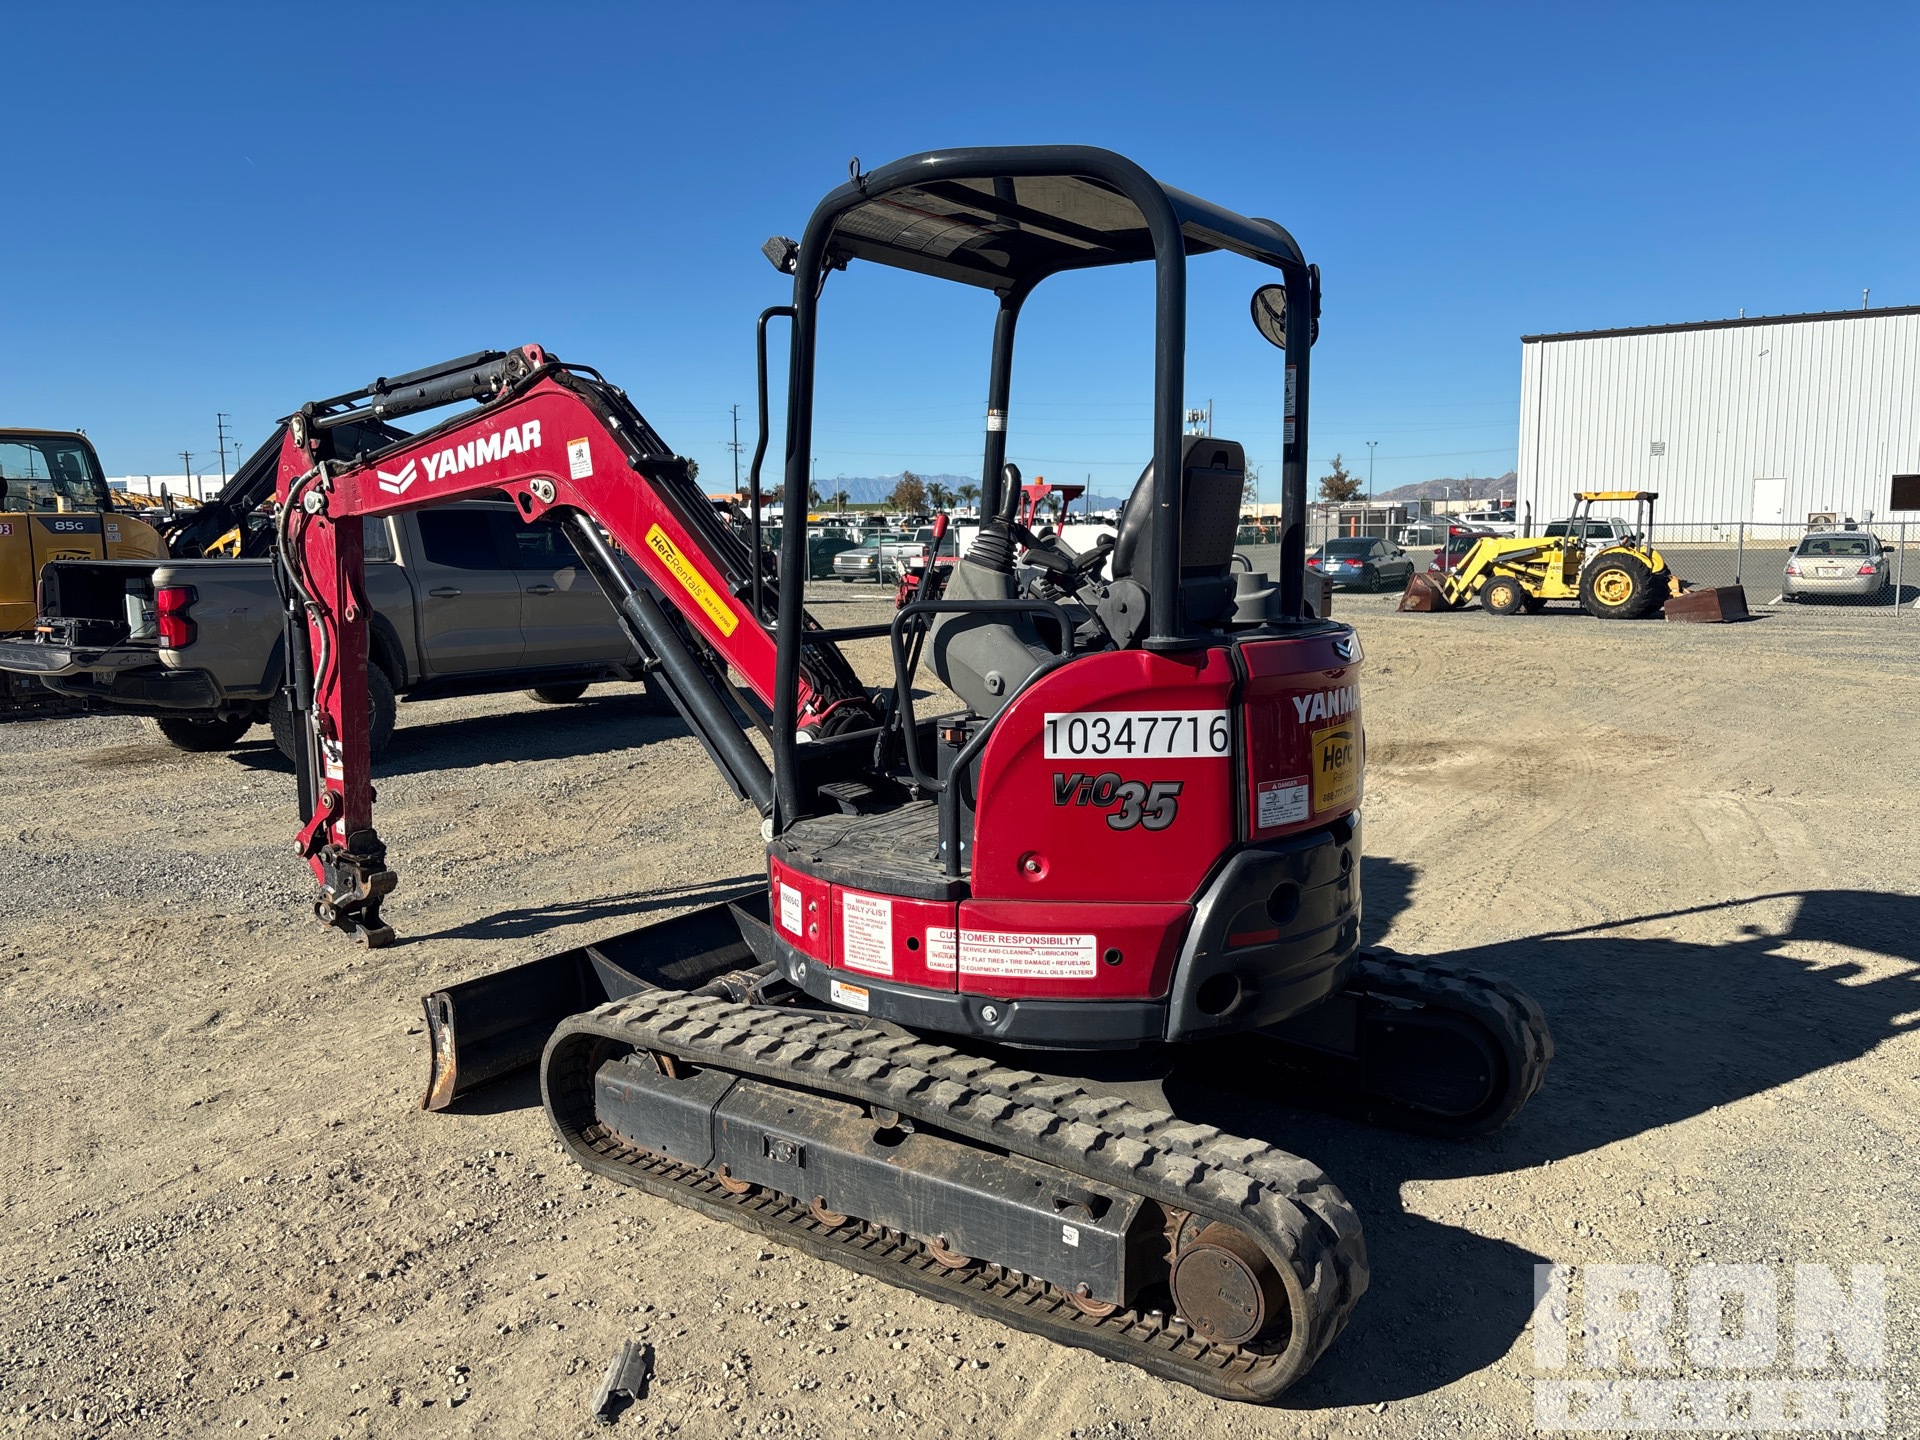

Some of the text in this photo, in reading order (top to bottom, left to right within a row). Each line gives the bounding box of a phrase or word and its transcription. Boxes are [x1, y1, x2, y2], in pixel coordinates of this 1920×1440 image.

[420, 419, 542, 483] YANMAR
[55, 521, 84, 531] 85G
[1046, 715, 1229, 755] 10347716
[1322, 743, 1353, 773] Herc
[1332, 766, 1353, 785] Rentals
[1277, 780, 1298, 789] DANGER
[847, 903, 865, 914] DAILY
[855, 898, 877, 907] MINIMUM
[939, 930, 1081, 946] CUSTOMER RESPONSIBILITY
[929, 961, 954, 969] DAMAGE
[966, 965, 1000, 973] EQUIPMENT
[1004, 967, 1033, 975] BATTERY
